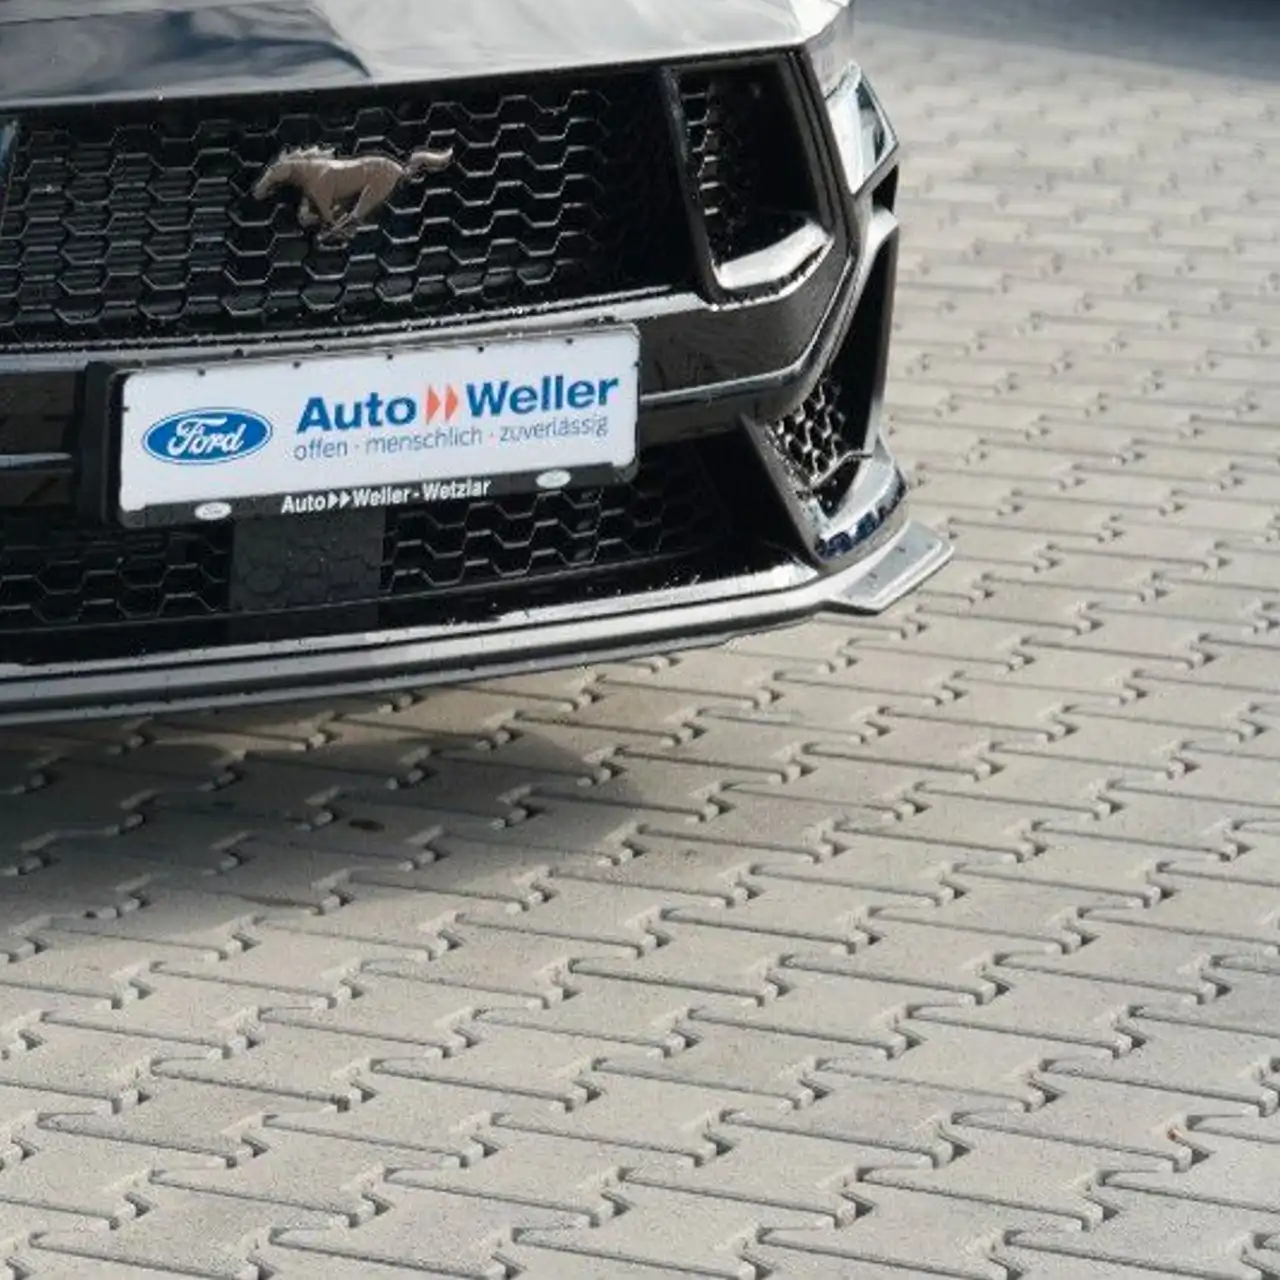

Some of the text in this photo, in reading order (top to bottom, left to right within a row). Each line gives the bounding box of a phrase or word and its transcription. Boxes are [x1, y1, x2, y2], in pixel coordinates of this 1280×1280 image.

[296, 374, 619, 433] Auto Weller
[167, 416, 244, 456] Ford
[293, 436, 348, 461] offen
[365, 425, 482, 454] menschlich
[281, 495, 326, 514] Auto
[351, 486, 411, 507] Weller
[422, 478, 492, 501] Wetzlar
